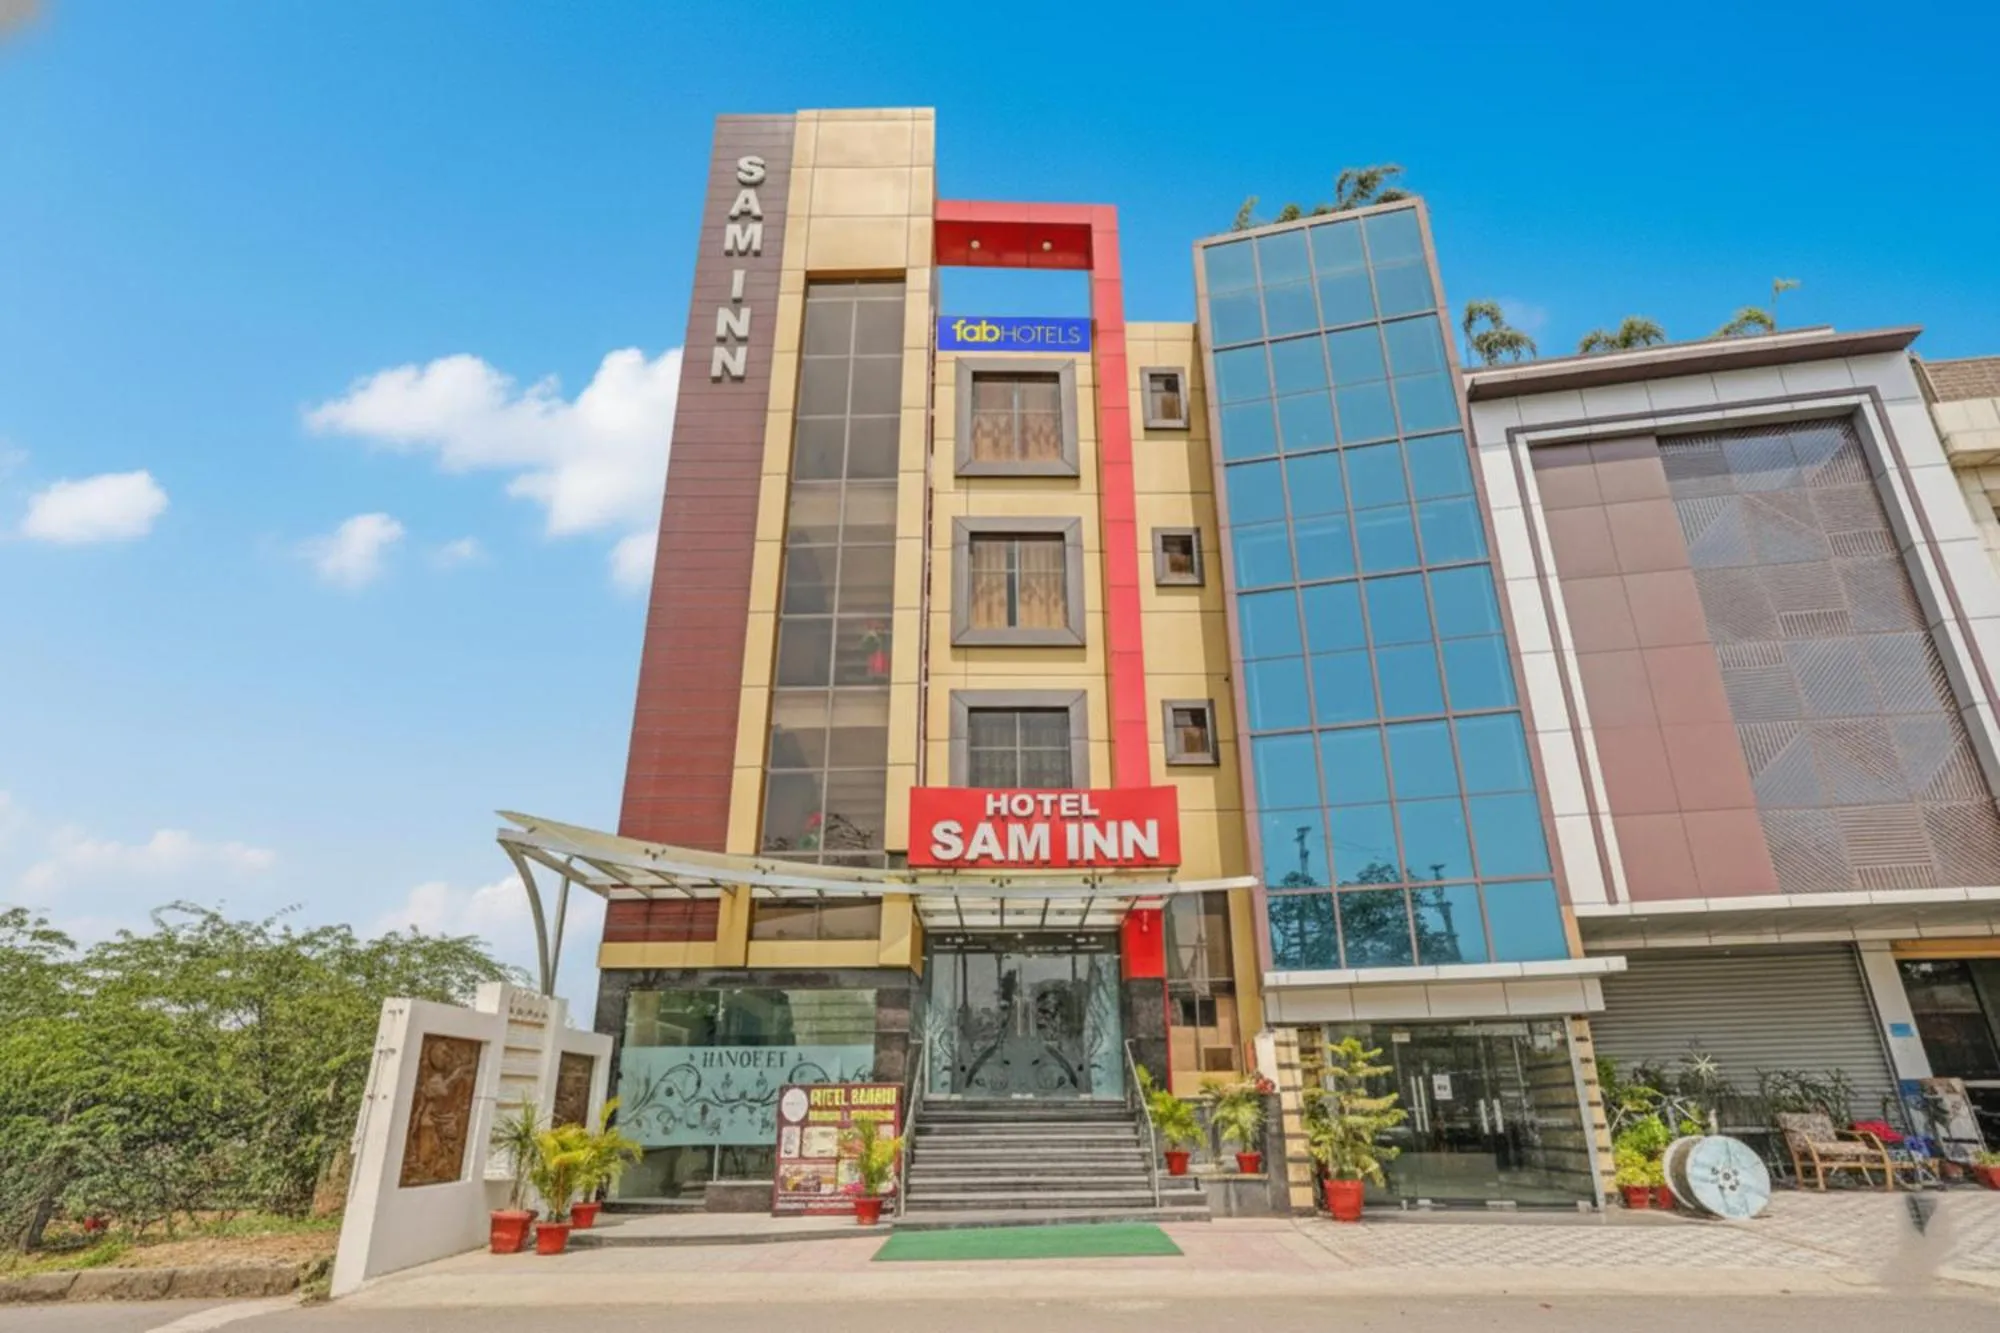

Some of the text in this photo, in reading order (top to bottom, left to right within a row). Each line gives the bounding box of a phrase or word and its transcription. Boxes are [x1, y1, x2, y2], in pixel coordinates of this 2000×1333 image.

[711, 155, 766, 384] SAM INN
[985, 793, 1100, 818] HOTEL
[930, 818, 1160, 862] SAM INN
